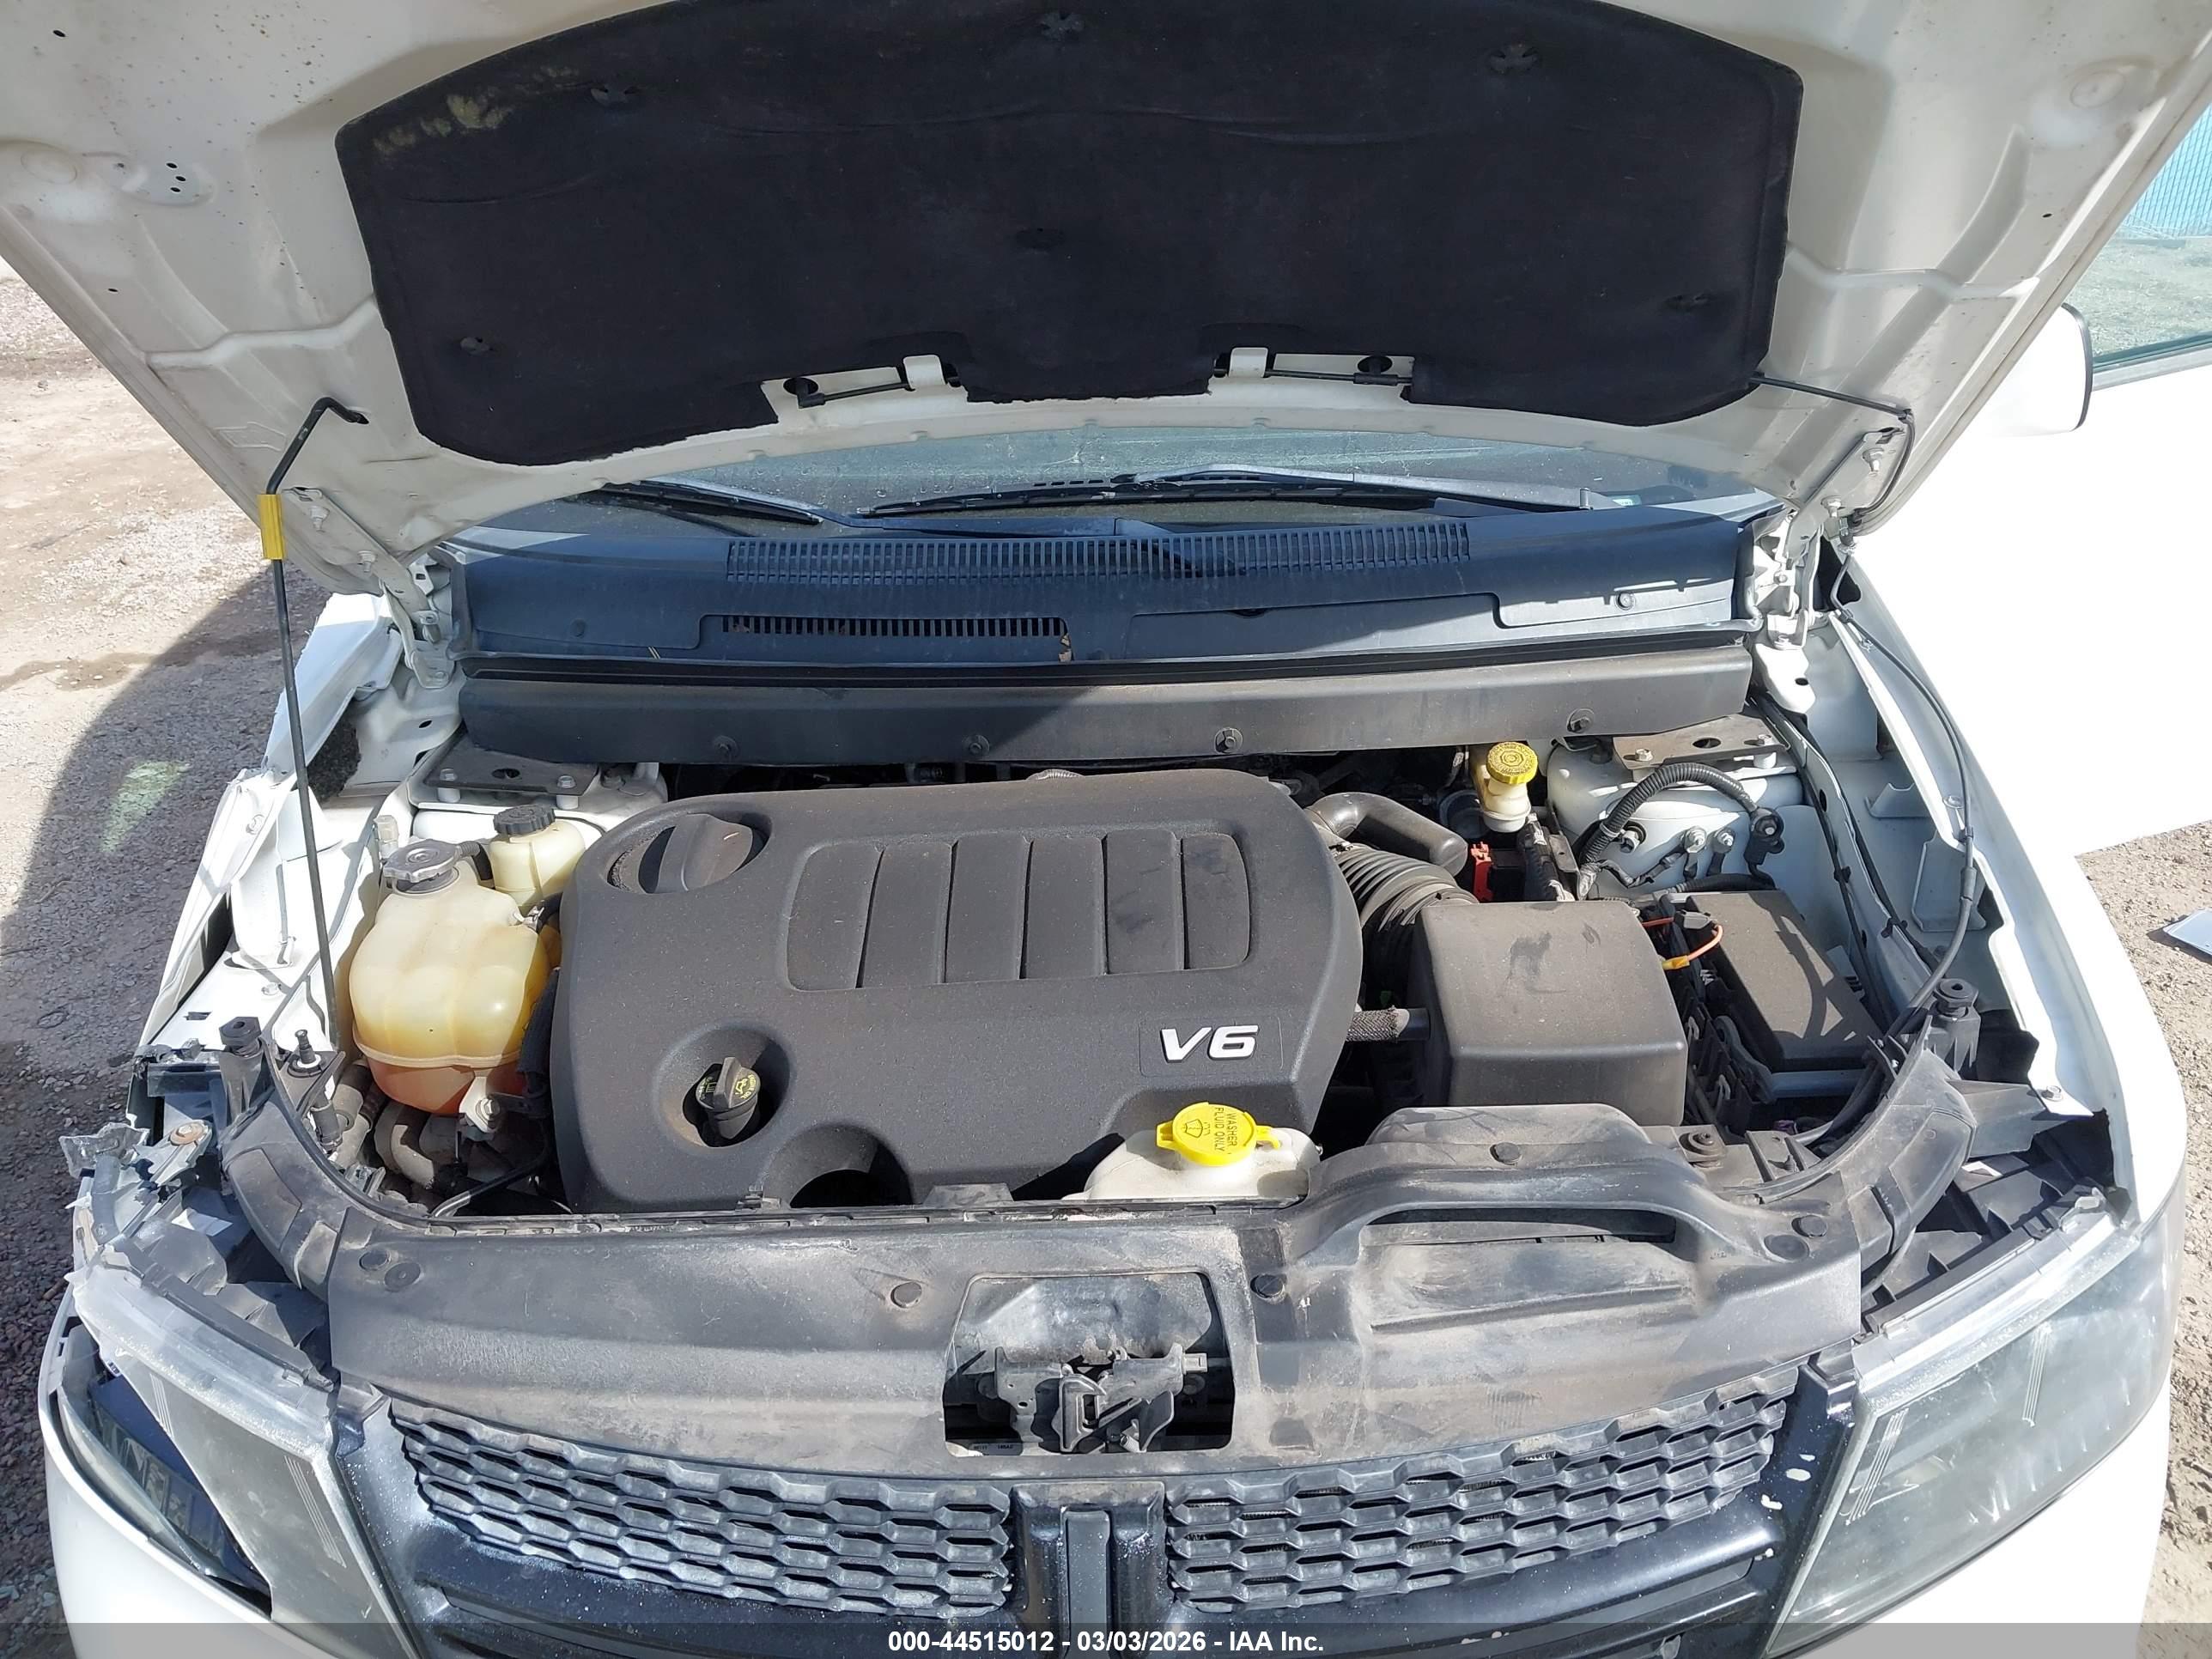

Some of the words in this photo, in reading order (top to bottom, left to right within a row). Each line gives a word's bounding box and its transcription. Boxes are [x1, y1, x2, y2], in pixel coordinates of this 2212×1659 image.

[1160, 1024, 1260, 1062] V6
[1213, 1107, 1225, 1129] FLUID
[1226, 1112, 1238, 1146] WASHER
[1213, 1131, 1225, 1152] ONLY
